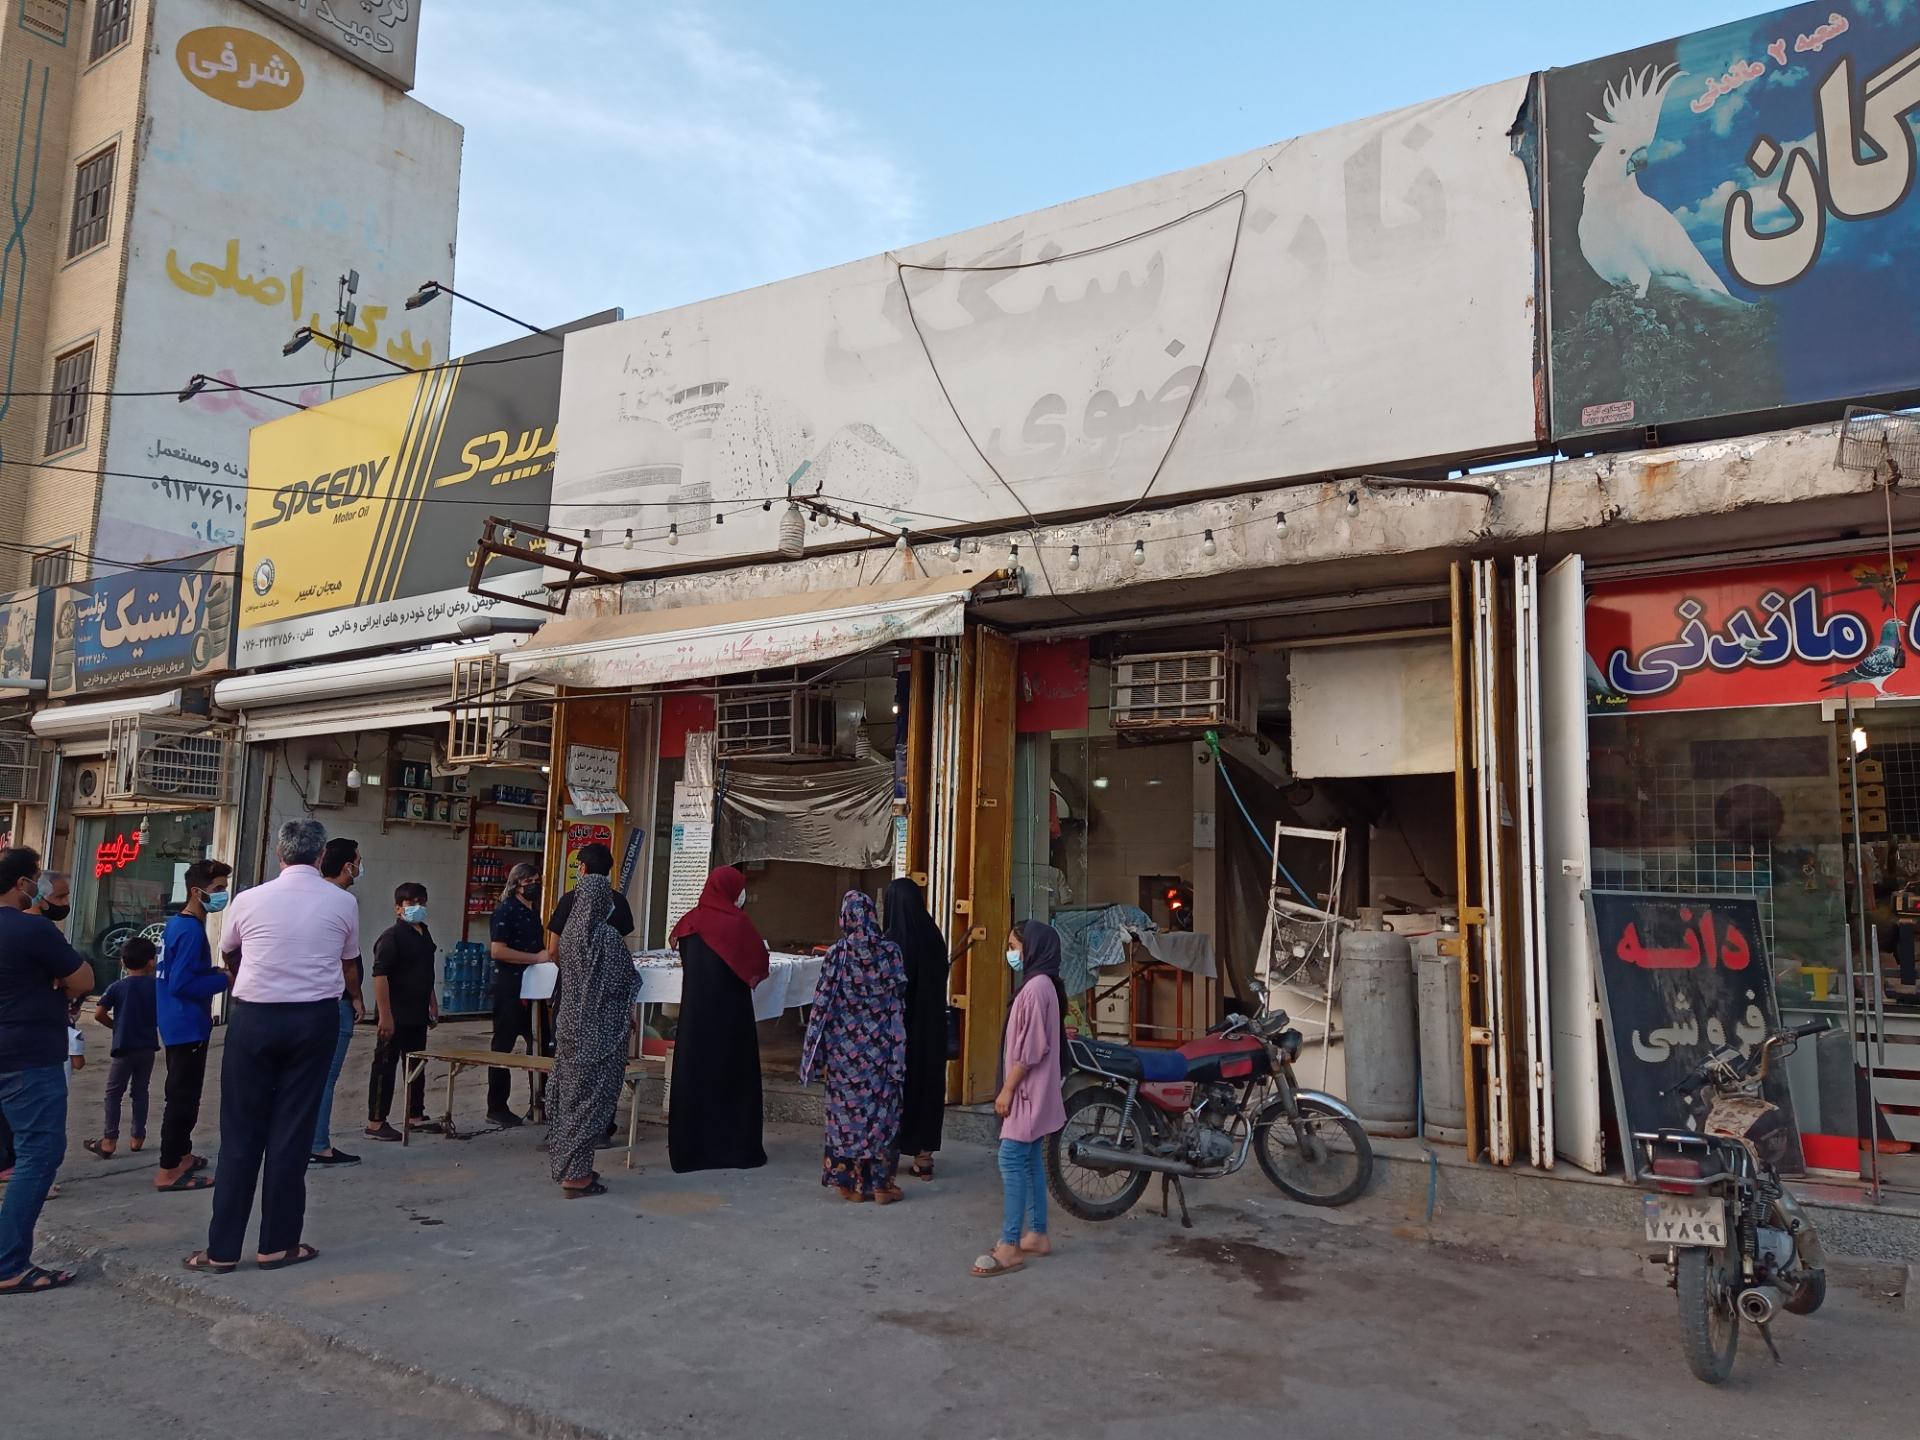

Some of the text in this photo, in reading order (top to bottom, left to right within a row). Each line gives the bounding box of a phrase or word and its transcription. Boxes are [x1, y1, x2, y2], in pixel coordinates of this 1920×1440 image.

[1767, 38, 1787, 66] ۲
[187, 40, 291, 88] شرفی
[165, 238, 305, 323] اصلی
[252, 455, 390, 531] SPEEDY
[332, 505, 370, 525] Motor Oil
[294, 580, 342, 603] هیجان تغییر
[77, 590, 109, 627] تولیپ
[100, 575, 203, 659] لاستیک
[427, 605, 445, 621] انواع
[447, 601, 470, 618] روغن
[328, 621, 351, 637] خارجی
[359, 616, 381, 632] ایرانی
[382, 615, 398, 627] های
[400, 612, 425, 627] خودرو
[1608, 586, 1868, 695] ماندنی
[120, 670, 130, 681] های
[151, 664, 166, 678] انواع
[166, 660, 184, 673] فروش
[1606, 694, 1629, 706] شعبه
[1616, 908, 1750, 970] دانه
[1632, 989, 1768, 1063] فروشی
